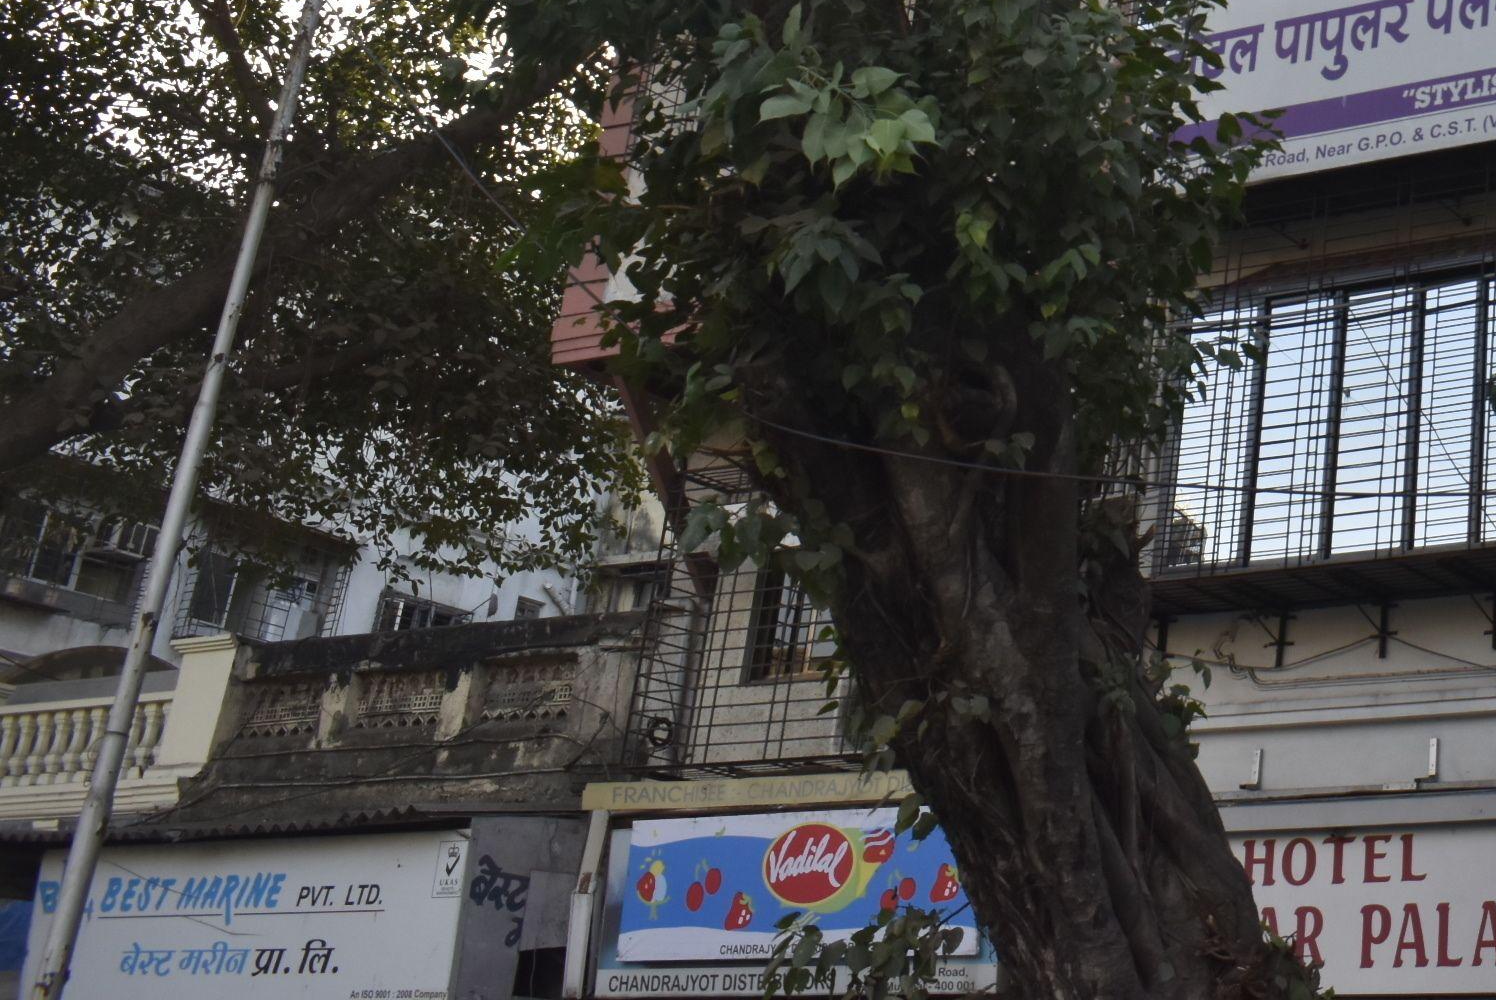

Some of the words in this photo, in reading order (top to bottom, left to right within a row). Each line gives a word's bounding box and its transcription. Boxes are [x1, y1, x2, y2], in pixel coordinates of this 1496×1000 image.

[1265, 150, 1310, 168] Road,
[1315, 143, 1353, 160] Near
[1357, 131, 1406, 151] G.P.O.
[1412, 126, 1425, 142] &
[1430, 117, 1477, 139] C.S.T.
[769, 830, 849, 888] Vadilal
[1243, 833, 1428, 887] HOTEL
[100, 875, 177, 913] BEST
[176, 872, 287, 926] MARINE
[296, 885, 335, 907] PVT.
[344, 884, 383, 906] LTD.
[119, 941, 177, 977] बेस्ट
[178, 940, 252, 976] मरीन
[719, 943, 778, 956] CHANDRAJY
[608, 973, 720, 993] CHANDRAJYOT
[934, 981, 955, 991] 400
[956, 981, 976, 991] 001
[938, 967, 969, 978] Road,
[361, 989, 374, 999] ISO
[414, 989, 448, 1000] Company
